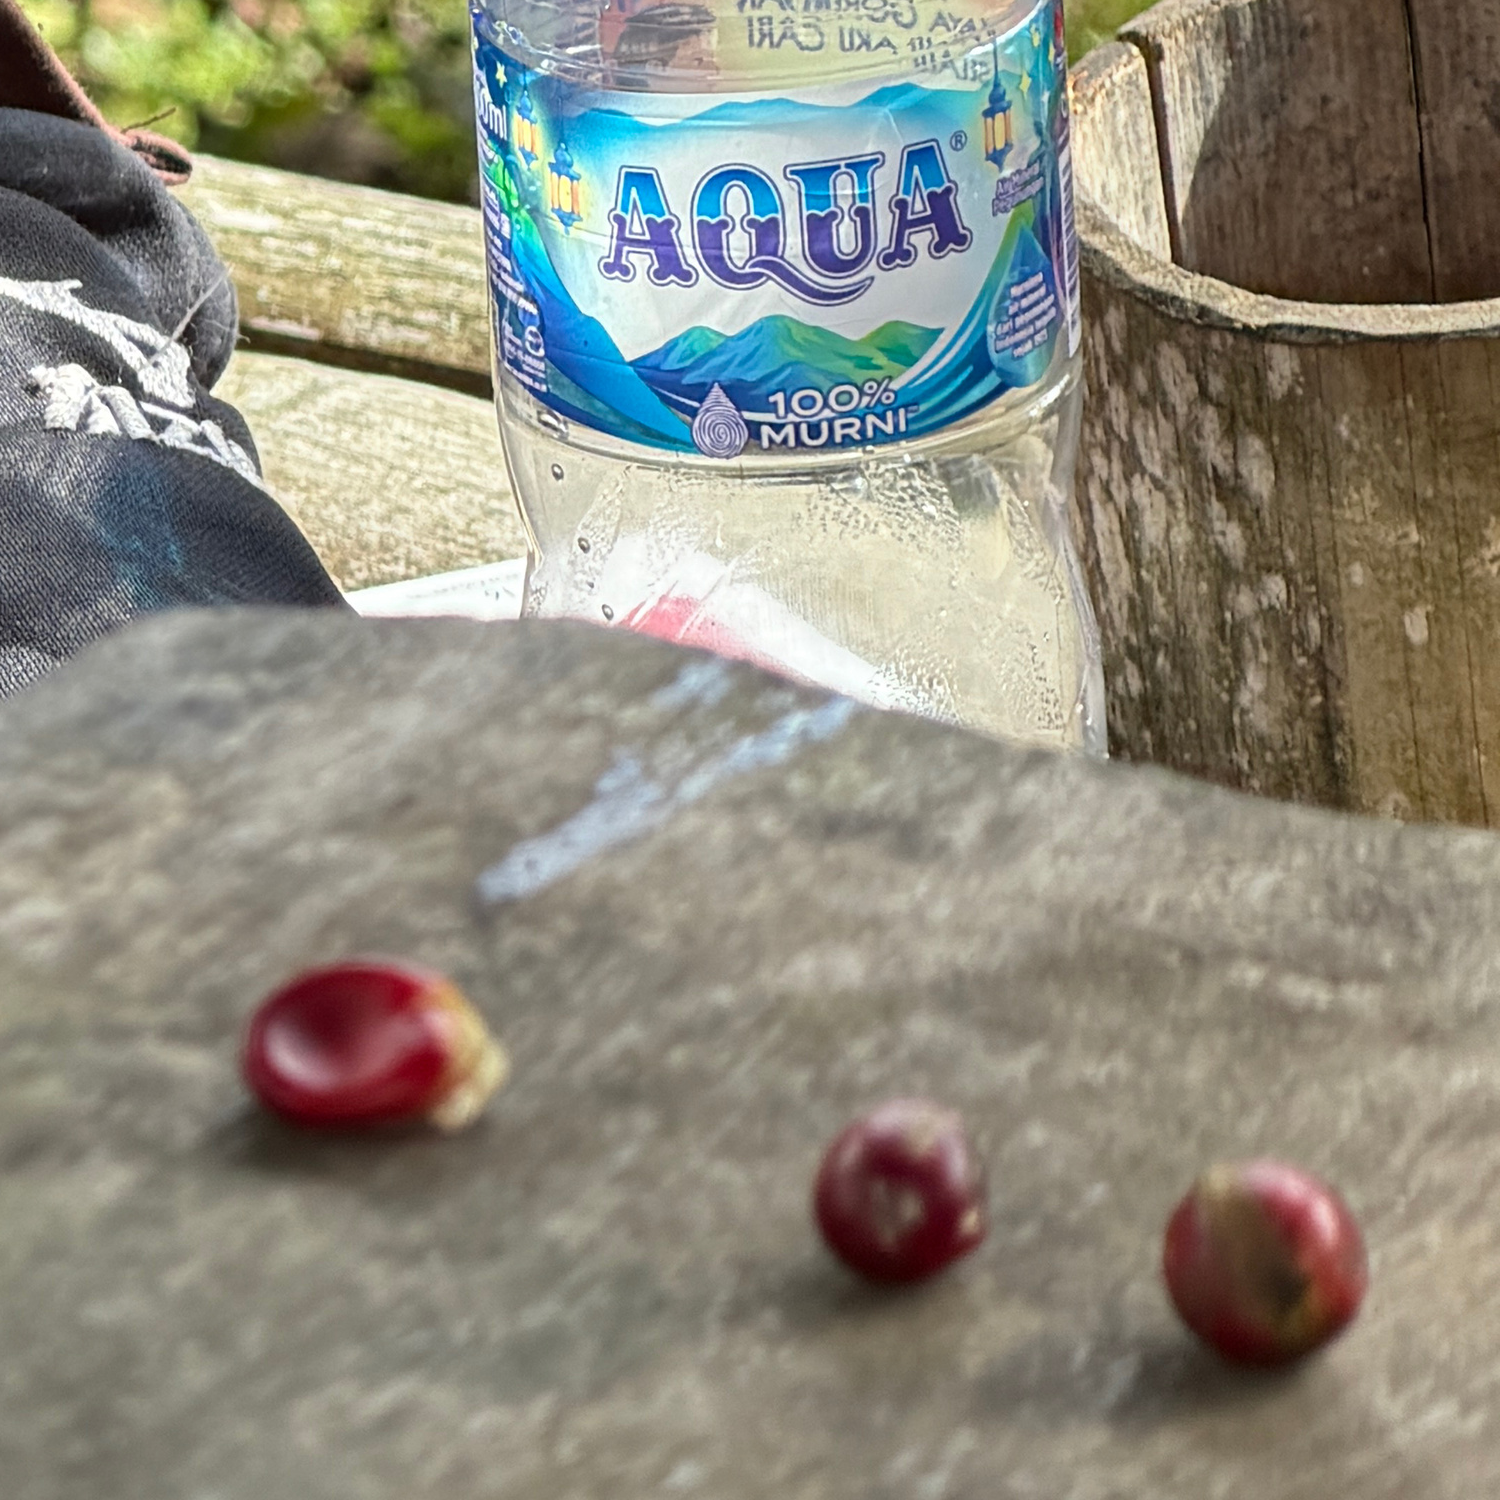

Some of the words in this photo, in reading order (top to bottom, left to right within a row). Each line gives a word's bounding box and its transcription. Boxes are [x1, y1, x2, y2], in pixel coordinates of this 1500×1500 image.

[598, 139, 973, 306] AQUA
[767, 377, 896, 419] 100%
[759, 410, 910, 450] MURNI
